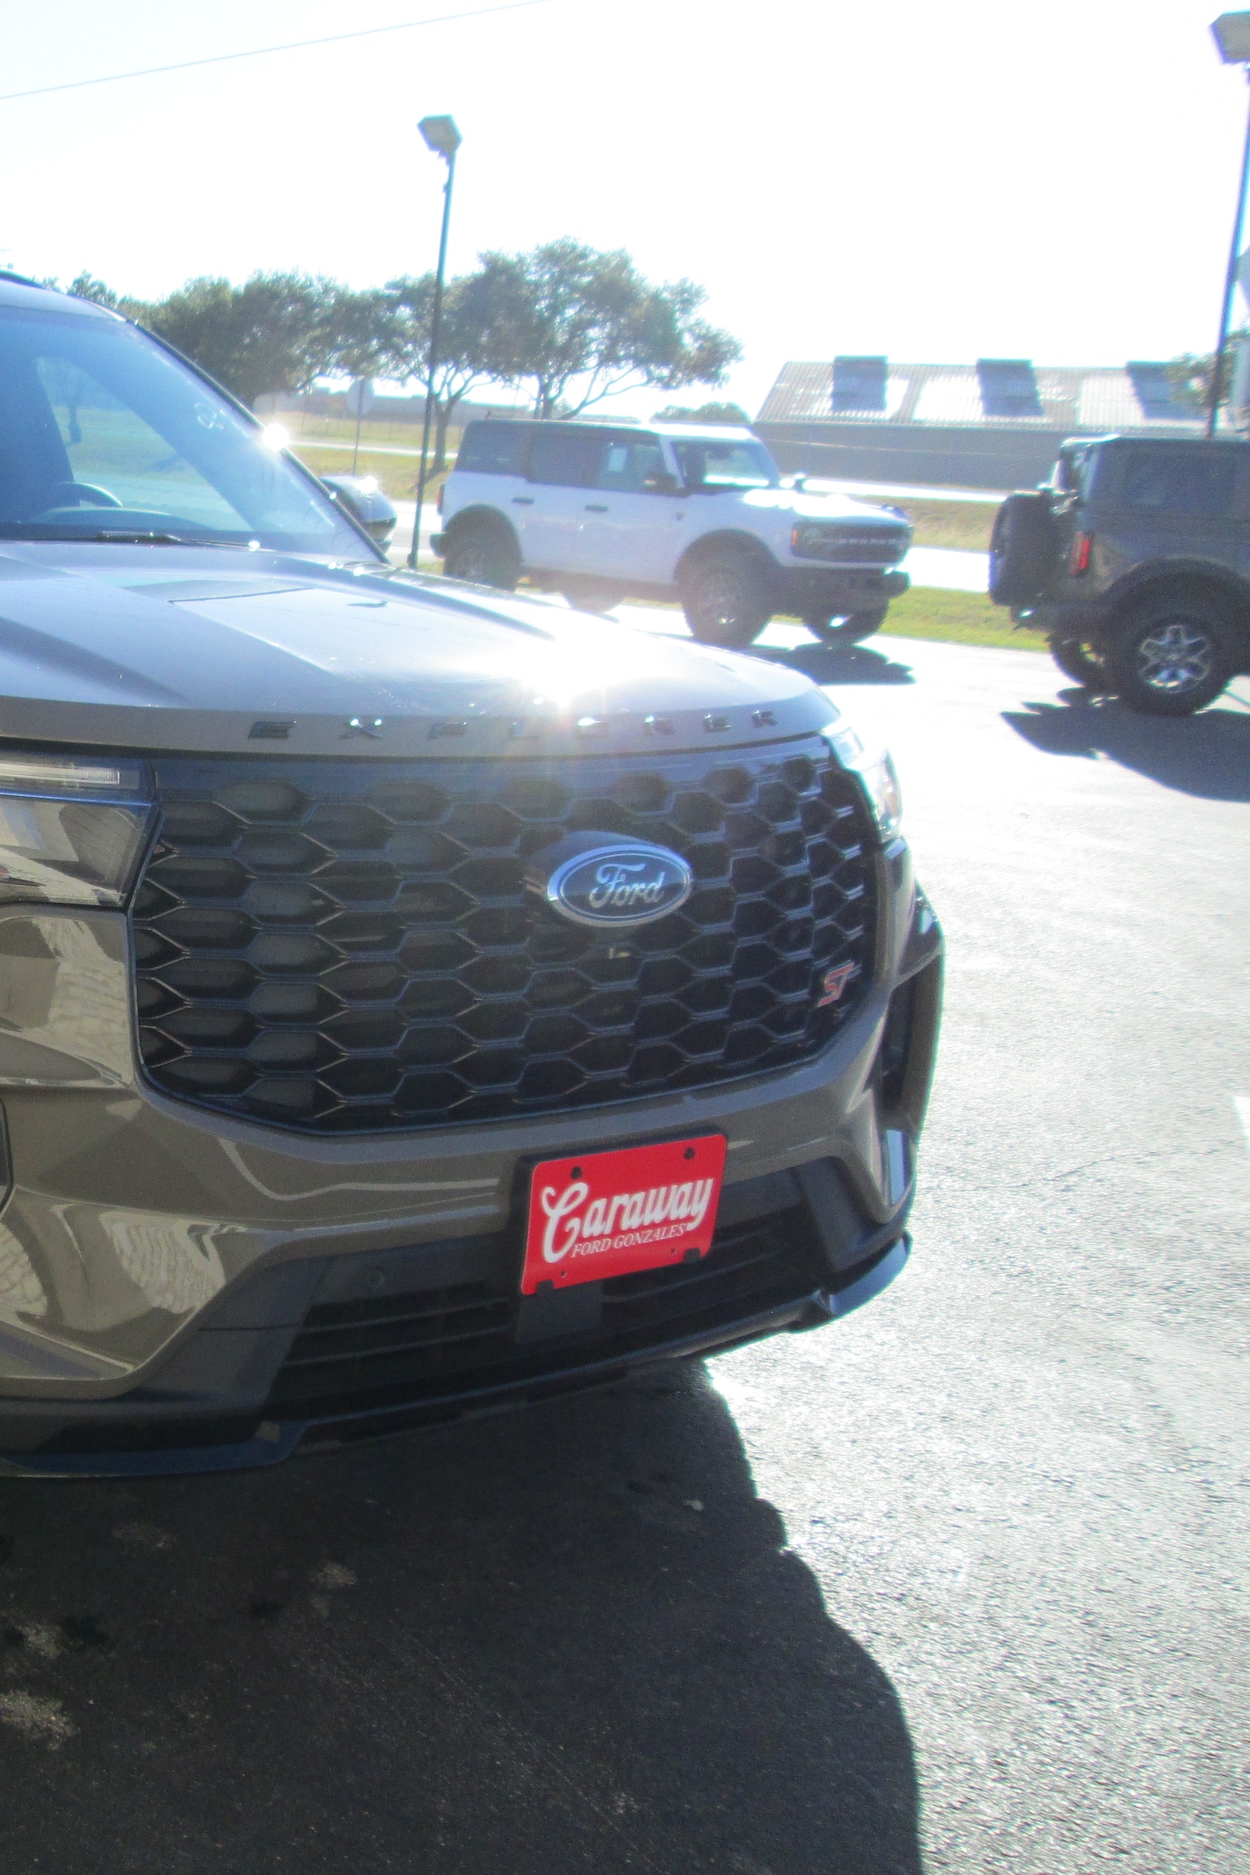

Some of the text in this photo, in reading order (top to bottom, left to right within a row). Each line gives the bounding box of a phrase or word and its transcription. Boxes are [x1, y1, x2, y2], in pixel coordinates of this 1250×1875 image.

[247, 709, 780, 741] EXPLORER
[589, 863, 666, 909] Ford
[541, 1178, 714, 1264] Caraway
[570, 1222, 687, 1259] FORD GONZALES
